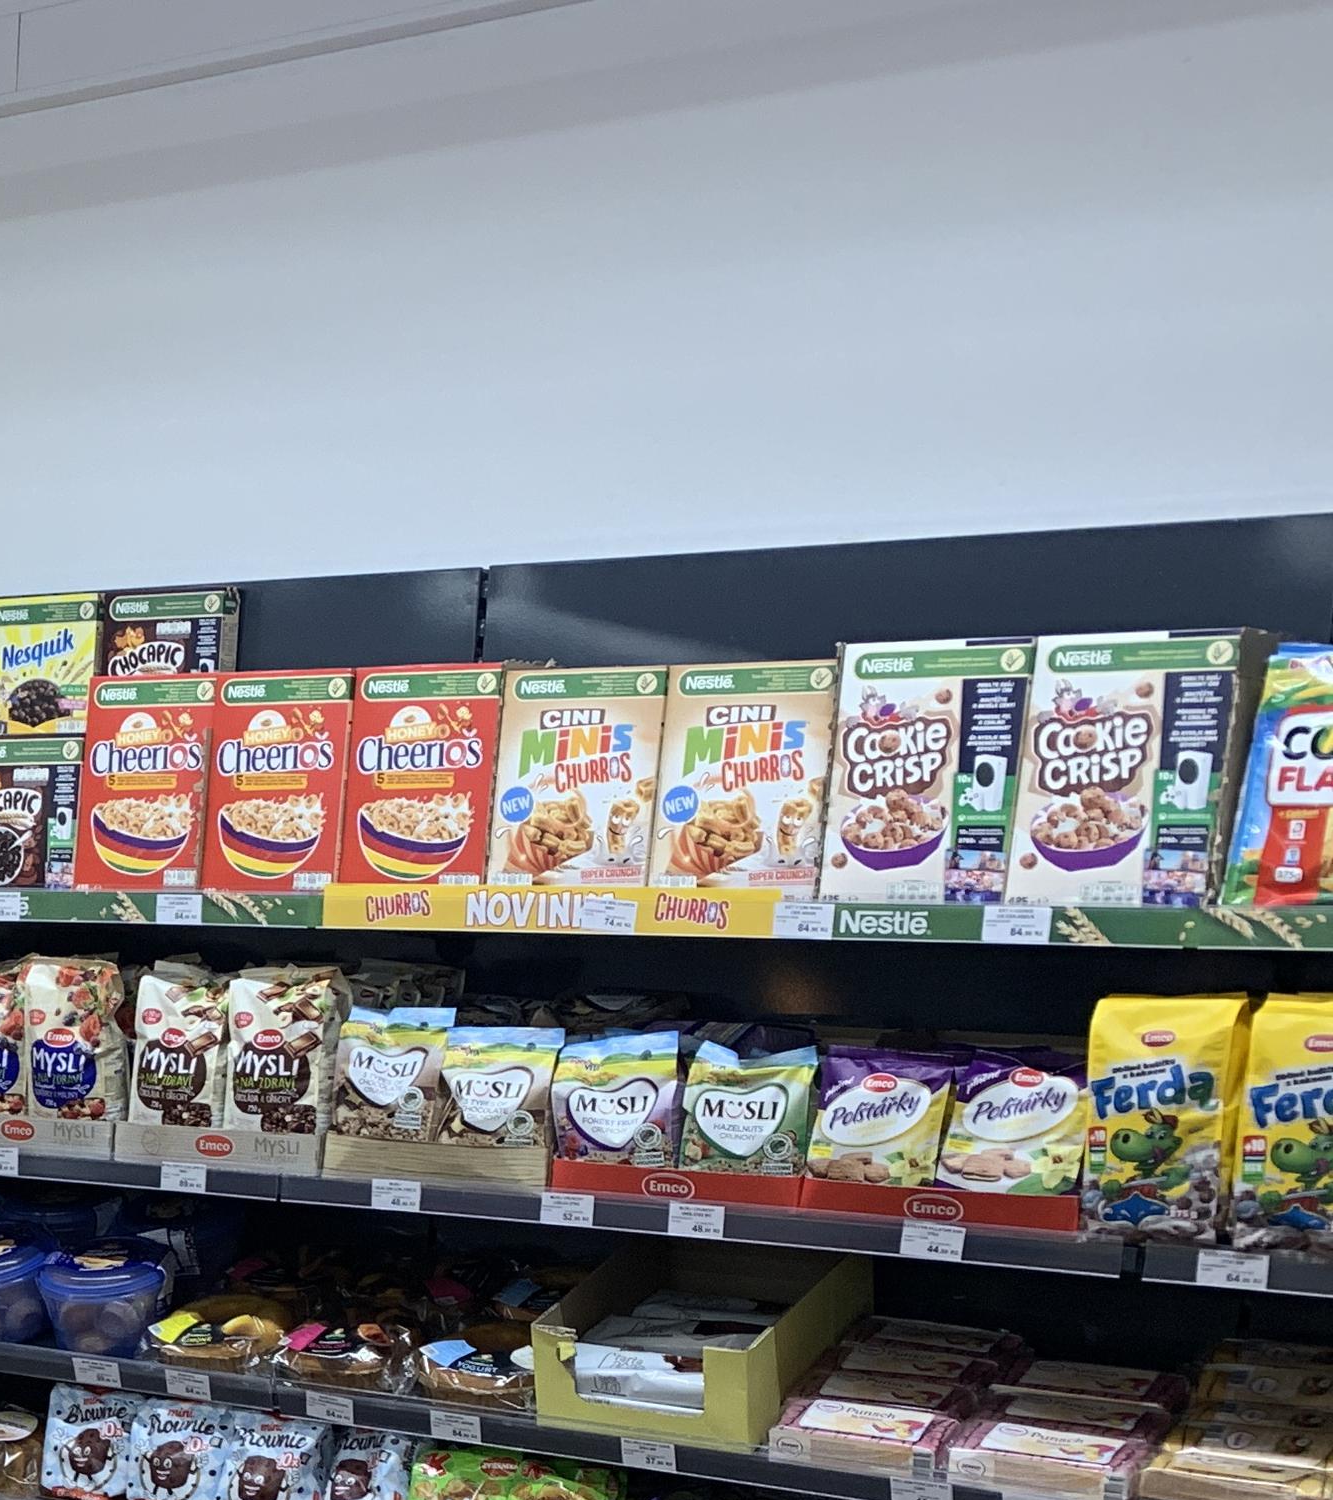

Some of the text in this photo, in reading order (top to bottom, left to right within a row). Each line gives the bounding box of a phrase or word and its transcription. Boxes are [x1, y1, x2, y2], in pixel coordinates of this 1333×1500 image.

[1, 630, 75, 669] Nesquik
[861, 656, 916, 674] Nestlé
[1054, 649, 1114, 667] Nestlé
[542, 709, 602, 729] CINI
[708, 706, 776, 723] CINI
[91, 739, 202, 774] Cheerios
[217, 738, 333, 774] Cheerios
[357, 736, 482, 773] Cheerios
[554, 752, 633, 793] CHURROS
[722, 750, 805, 793] CHURROS
[501, 795, 533, 814] NEW
[663, 794, 696, 814] NEW
[365, 890, 431, 926] CHURROS
[465, 890, 615, 928] NOVIN
[653, 893, 729, 930] CHURROS
[838, 910, 931, 937] Nestlé
[32, 1046, 85, 1077] MYSLI
[141, 1046, 197, 1078] MYSLI
[236, 1048, 299, 1081] MYSLI
[864, 1077, 896, 1090] Emco
[1090, 1064, 1215, 1120] Ferda
[3, 1124, 33, 1138] Emco
[198, 1138, 231, 1153] Emco
[648, 1179, 689, 1196] Emco
[912, 1199, 957, 1215] Emco
